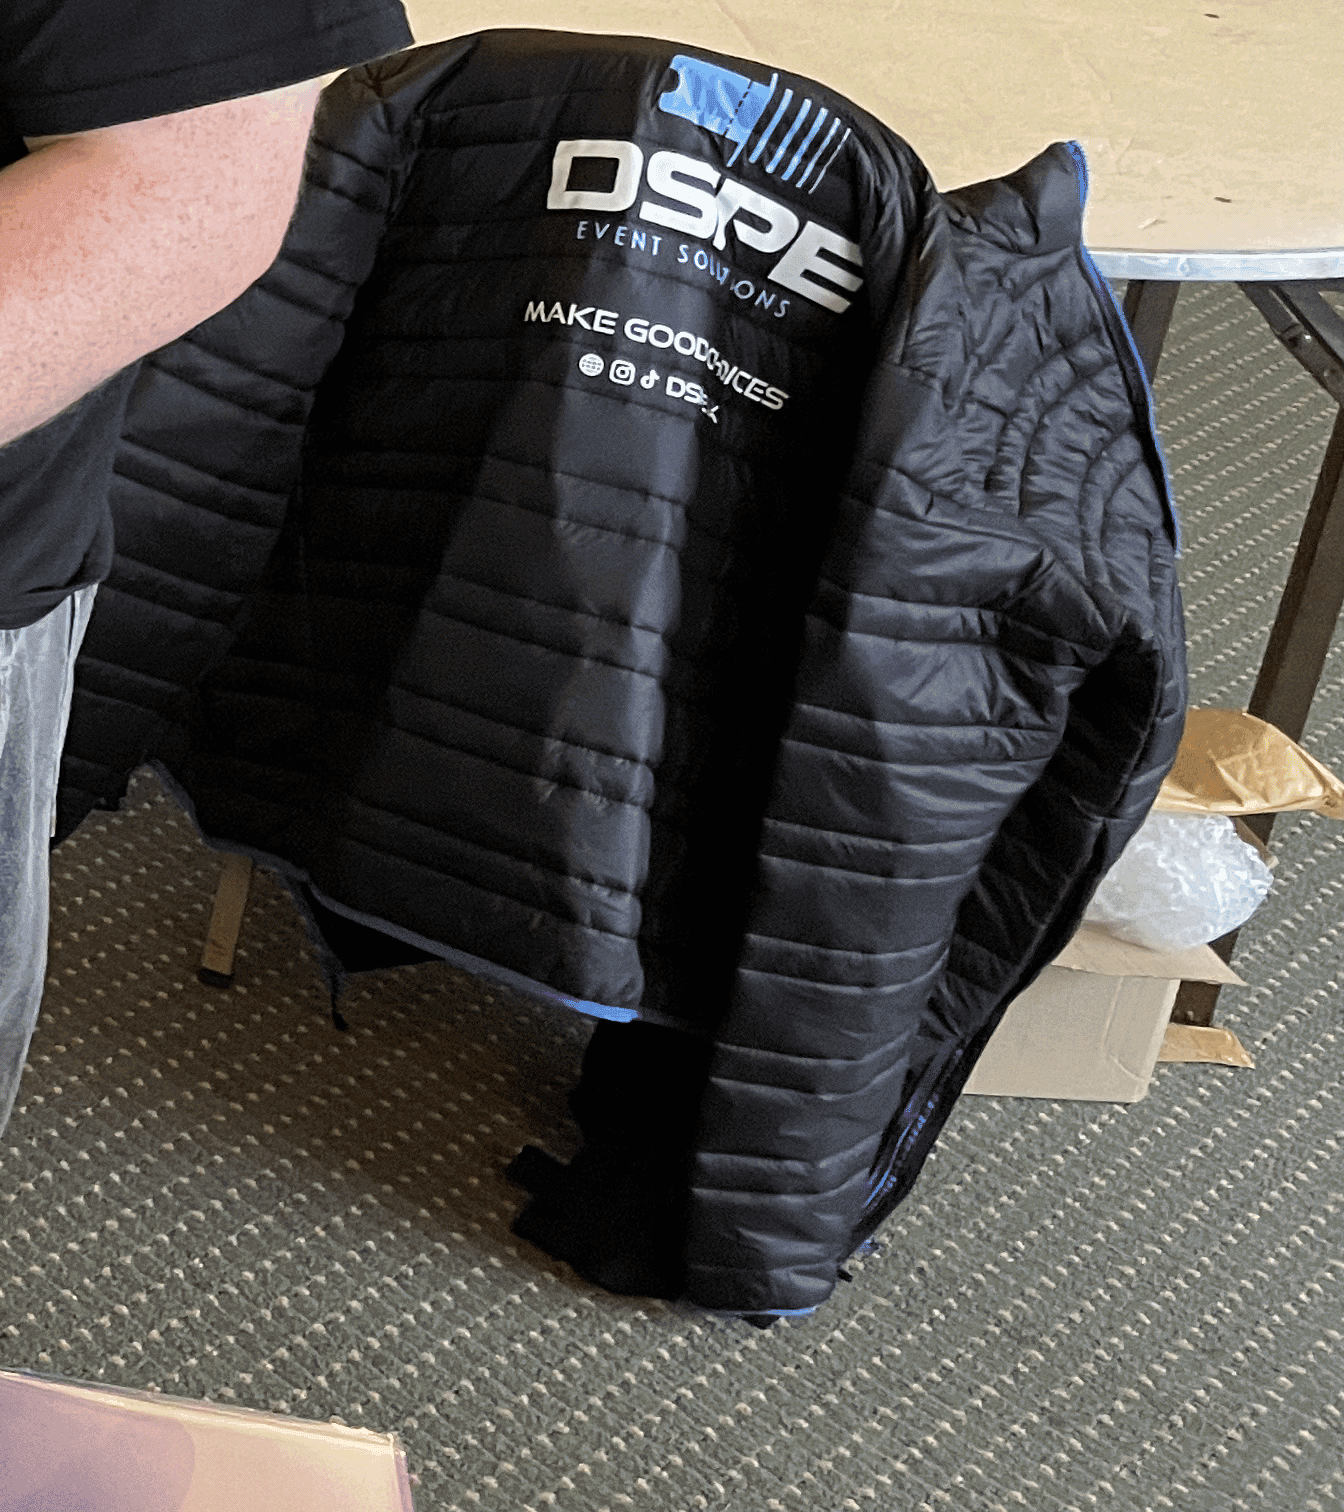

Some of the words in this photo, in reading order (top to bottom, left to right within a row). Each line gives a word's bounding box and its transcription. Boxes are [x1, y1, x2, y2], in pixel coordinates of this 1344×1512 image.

[546, 139, 864, 314] DSPE
[576, 220, 662, 256] EVENT
[524, 300, 619, 334] MAKE
[624, 318, 710, 362] GOOD
